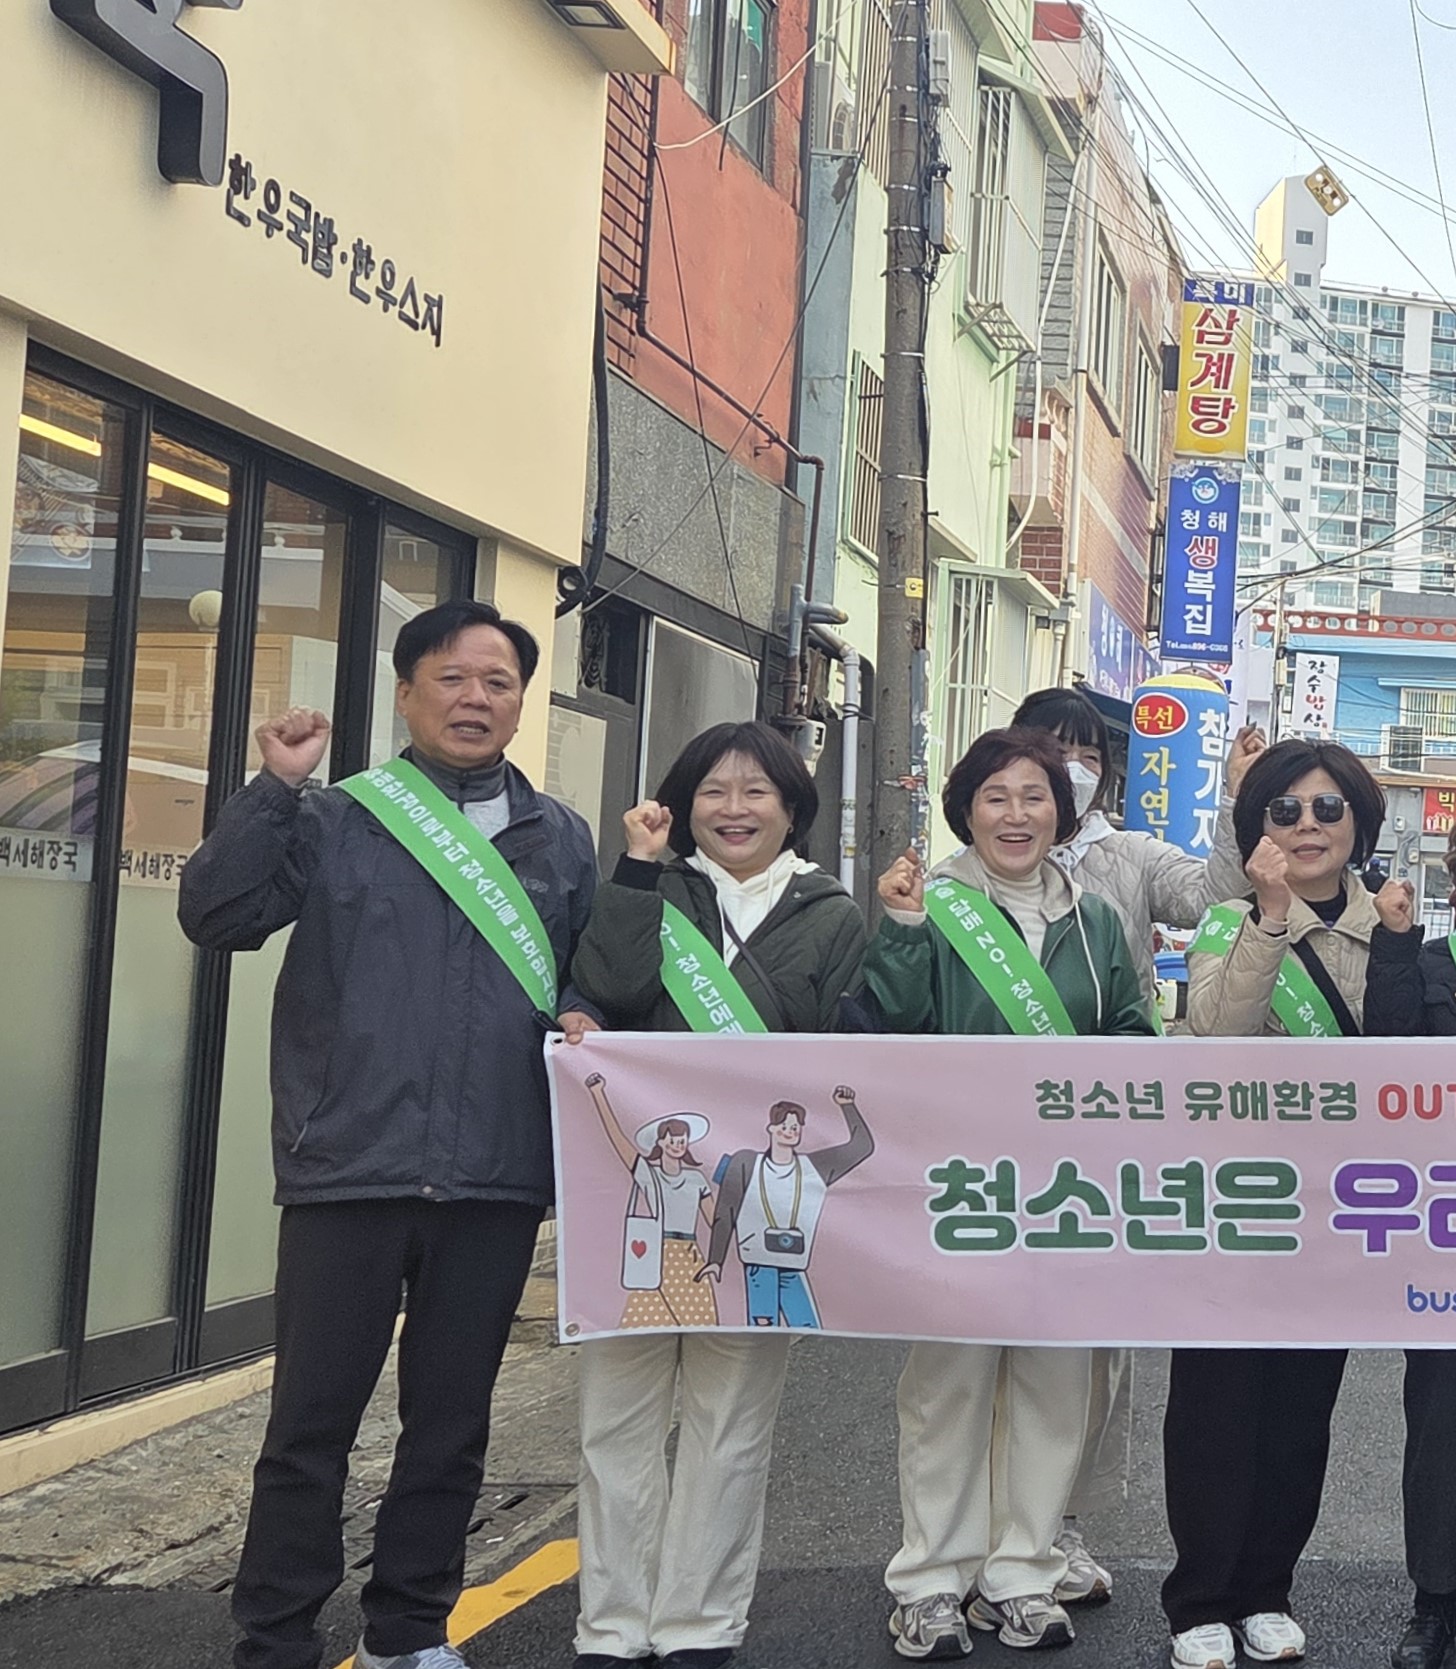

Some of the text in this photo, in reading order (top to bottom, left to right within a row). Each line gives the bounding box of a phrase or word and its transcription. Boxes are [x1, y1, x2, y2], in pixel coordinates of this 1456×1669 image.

[1190, 308, 1240, 436] 삼계탕
[1180, 508, 1228, 532] 청해
[1183, 535, 1219, 636] 생복집
[1136, 705, 1174, 730] 특선
[1304, 660, 1327, 727] 장수밥상
[0, 836, 78, 872] 백세해장국
[458, 859, 520, 927] 청소년을
[976, 931, 1014, 978] NO!
[1035, 1079, 1165, 1122] 청소년
[1185, 1080, 1358, 1122] 유해환경
[930, 1159, 1303, 1254] 청소년은
